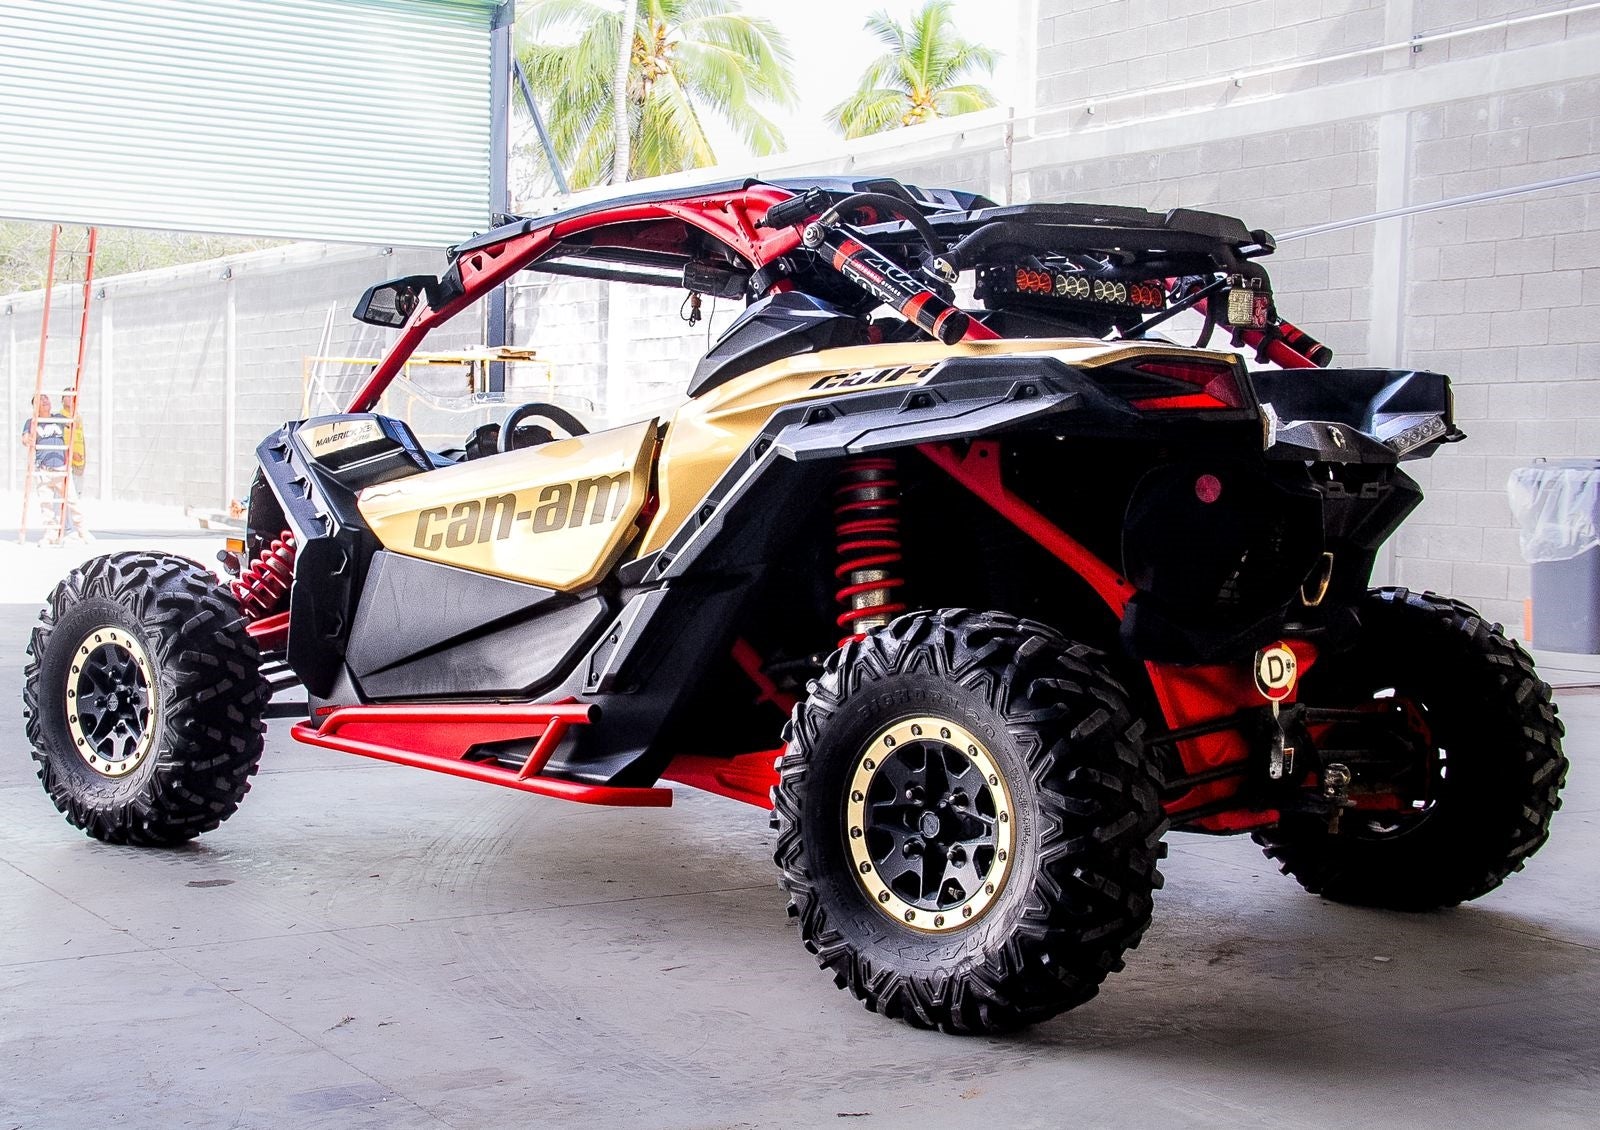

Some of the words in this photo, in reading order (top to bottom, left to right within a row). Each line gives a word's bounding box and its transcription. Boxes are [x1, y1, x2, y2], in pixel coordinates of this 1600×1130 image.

[881, 280, 901, 297] BYPASS
[315, 428, 357, 448] MAVERICK
[413, 471, 631, 551] can-am
[1267, 655, 1284, 683] D
